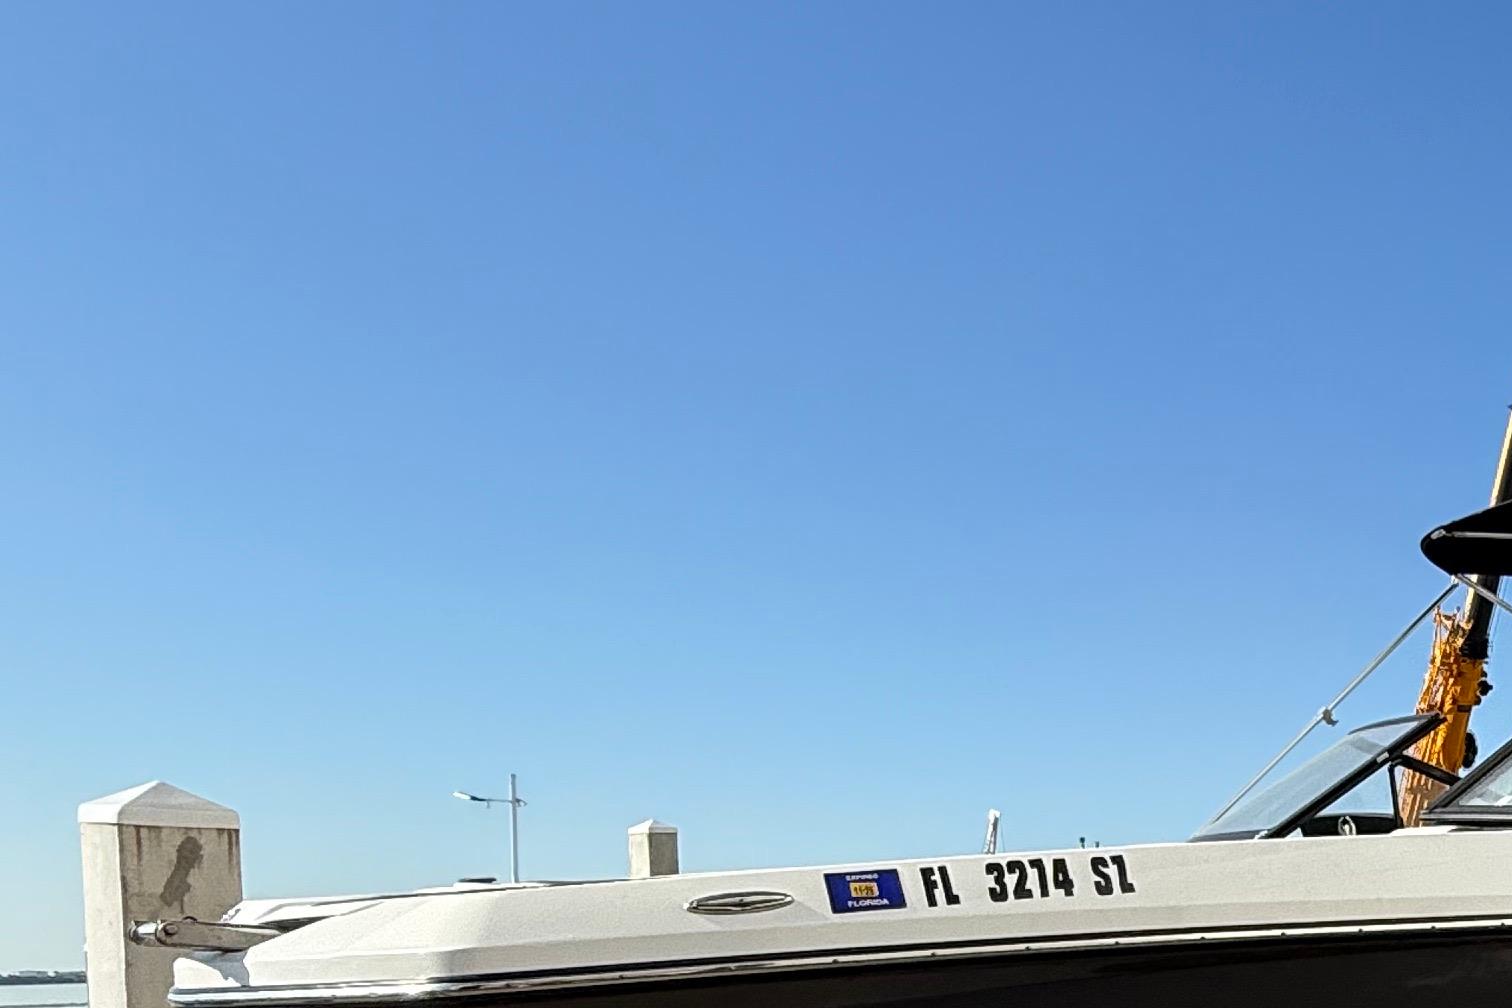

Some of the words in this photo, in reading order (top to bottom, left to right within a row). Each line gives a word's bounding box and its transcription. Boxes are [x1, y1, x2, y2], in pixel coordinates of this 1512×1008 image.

[919, 865, 961, 907] FL
[985, 857, 1075, 902] 3274
[1090, 854, 1136, 896] SZ
[847, 898, 890, 908] FLORIDA
